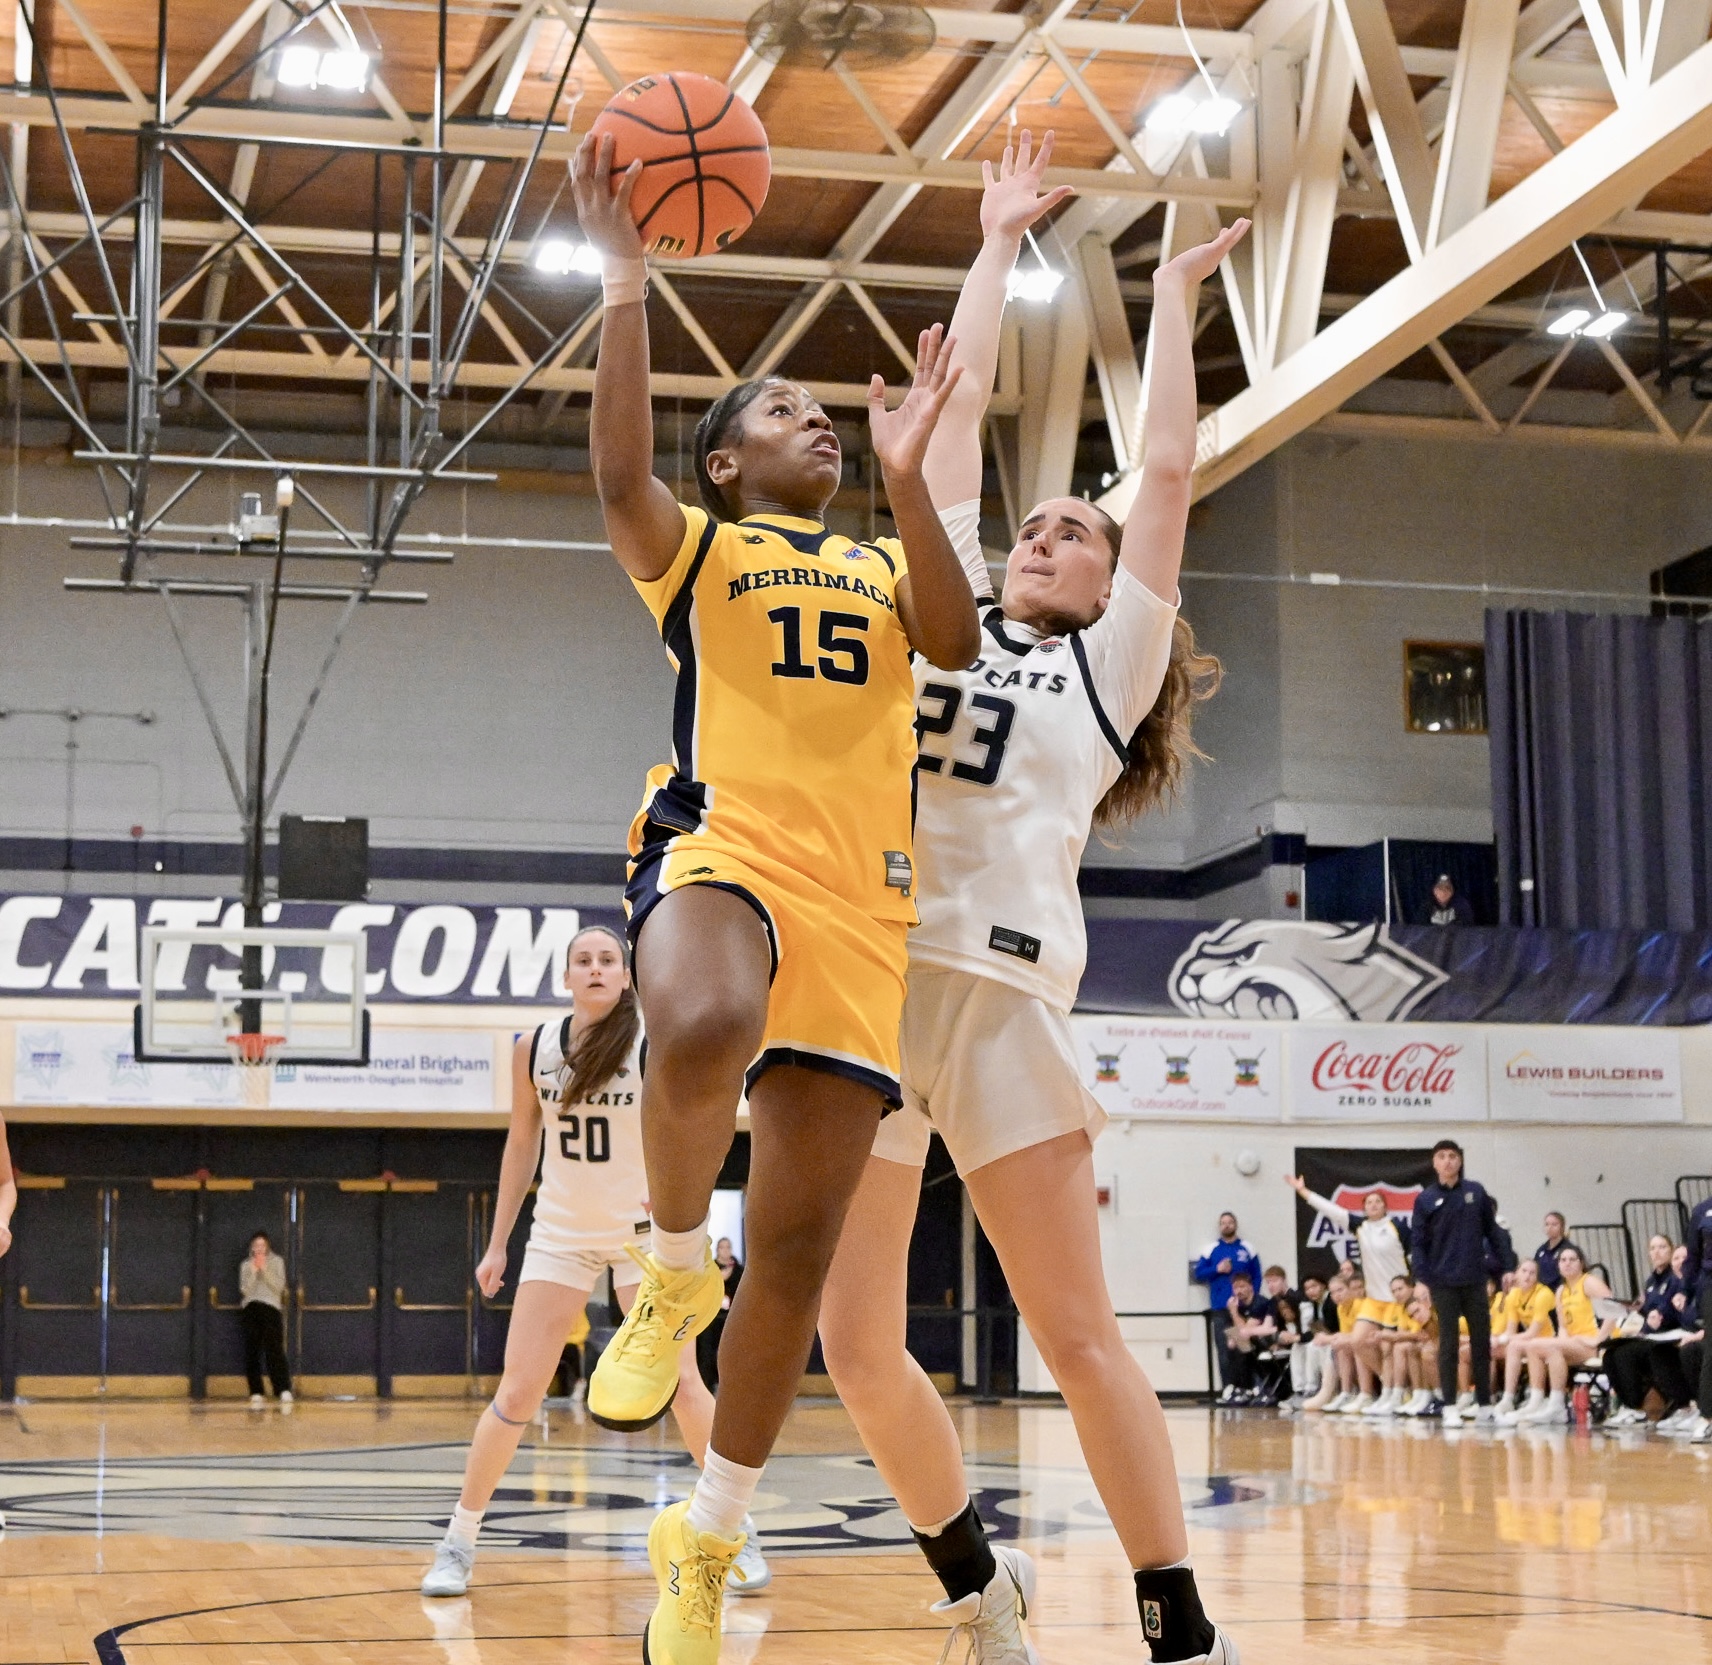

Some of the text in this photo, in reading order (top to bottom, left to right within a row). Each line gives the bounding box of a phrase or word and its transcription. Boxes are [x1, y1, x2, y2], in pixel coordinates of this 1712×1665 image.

[767, 605, 870, 687] 15
[911, 681, 1018, 787] 23
[0, 895, 580, 998] CATS.COM
[1024, 942, 1034, 954] M
[369, 1054, 490, 1073] eneral Brigham
[1311, 1040, 1463, 1093] Coca-Cola
[1506, 1065, 1664, 1081] LEWIS BUILDERS
[1338, 1095, 1432, 1108] ZERO SUGAR
[558, 1114, 611, 1163] 20
